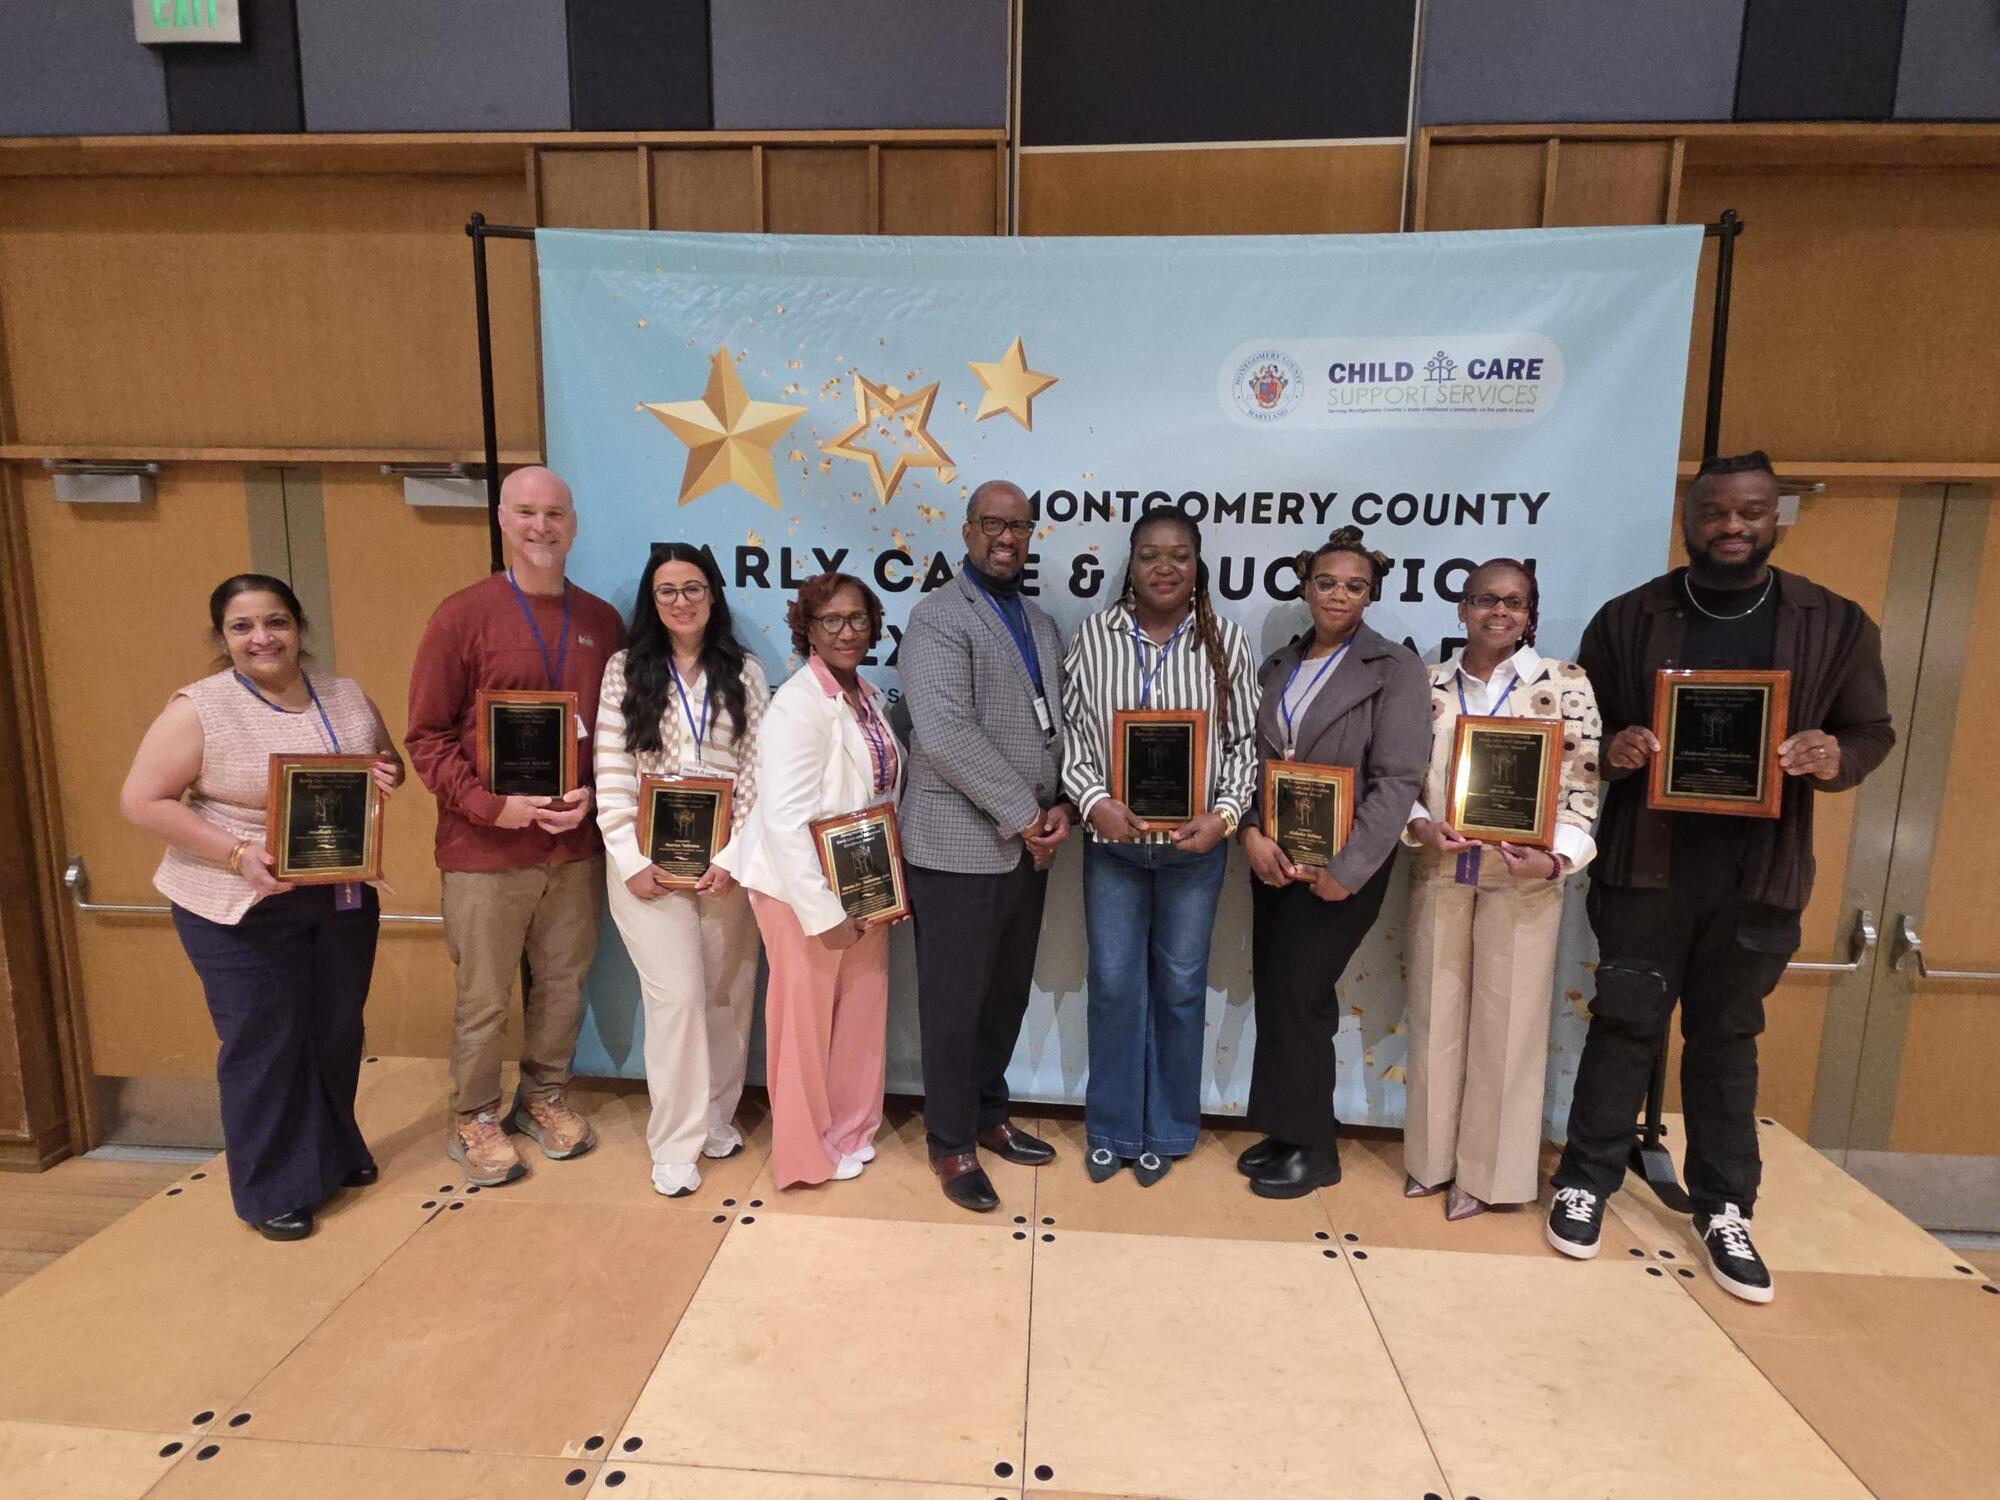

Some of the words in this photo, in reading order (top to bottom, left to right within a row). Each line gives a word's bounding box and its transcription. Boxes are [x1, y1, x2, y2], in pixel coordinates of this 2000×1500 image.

[1328, 362, 1414, 384] CHILD
[1467, 358, 1544, 381] CARE
[1328, 386, 1430, 407] SUPPORT
[1437, 384, 1539, 405] SERVICES
[1248, 408, 1288, 421] MARYLAND
[1352, 492, 1551, 527] COUNTY
[651, 543, 850, 588] RLY
[874, 549, 1041, 597] CAE
[1069, 553, 1105, 599] &
